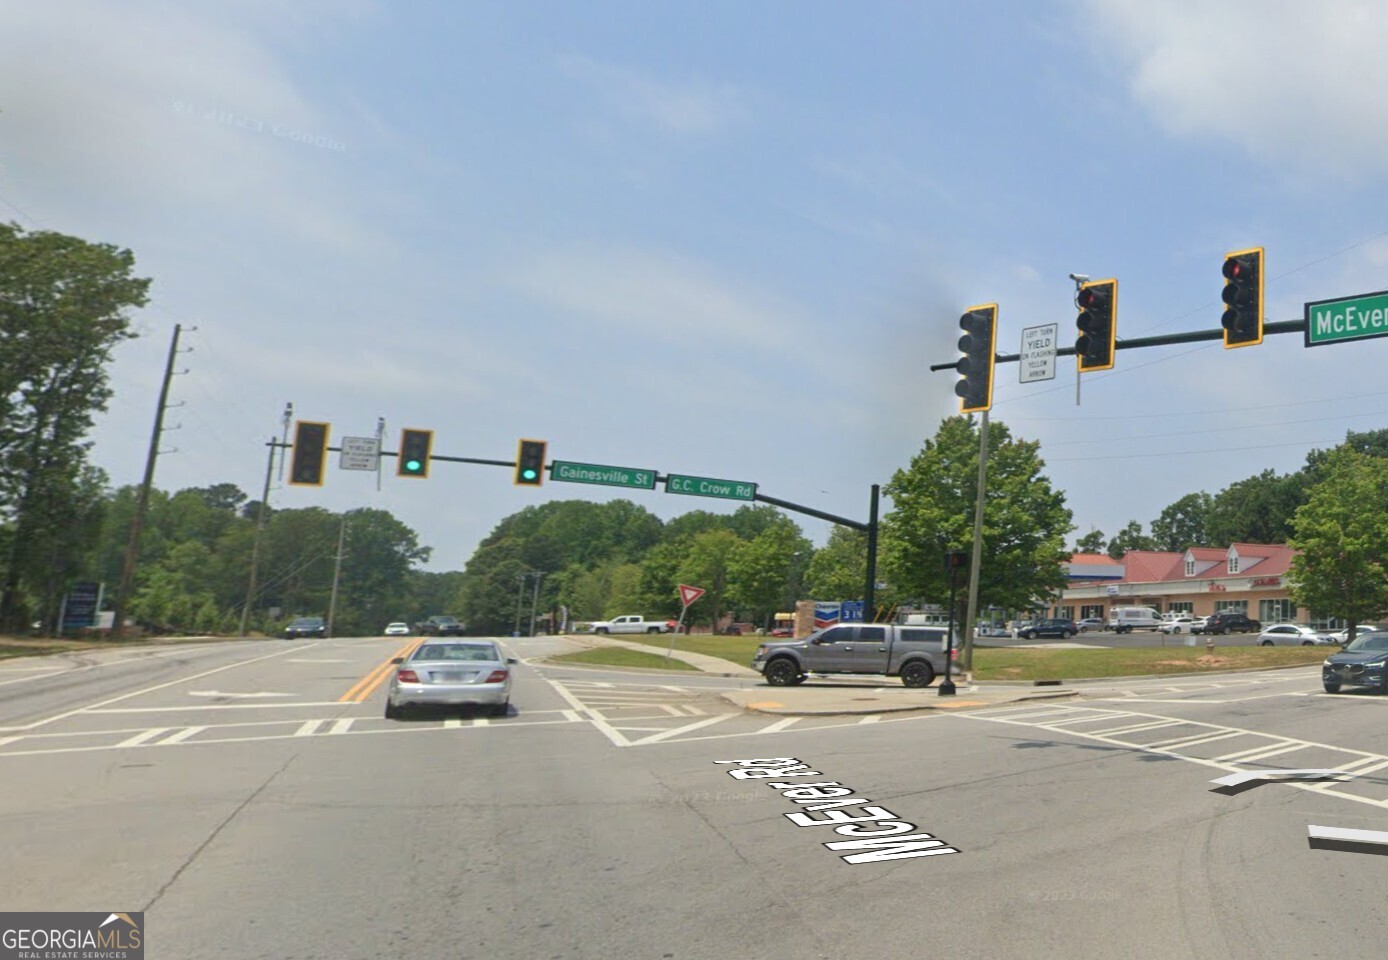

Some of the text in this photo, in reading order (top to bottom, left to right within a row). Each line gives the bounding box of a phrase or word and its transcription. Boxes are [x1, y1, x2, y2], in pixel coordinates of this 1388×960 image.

[1027, 338, 1050, 349] YIELD
[559, 465, 648, 485] Gainesville St
[672, 478, 751, 497] G.C. Crow Rd
